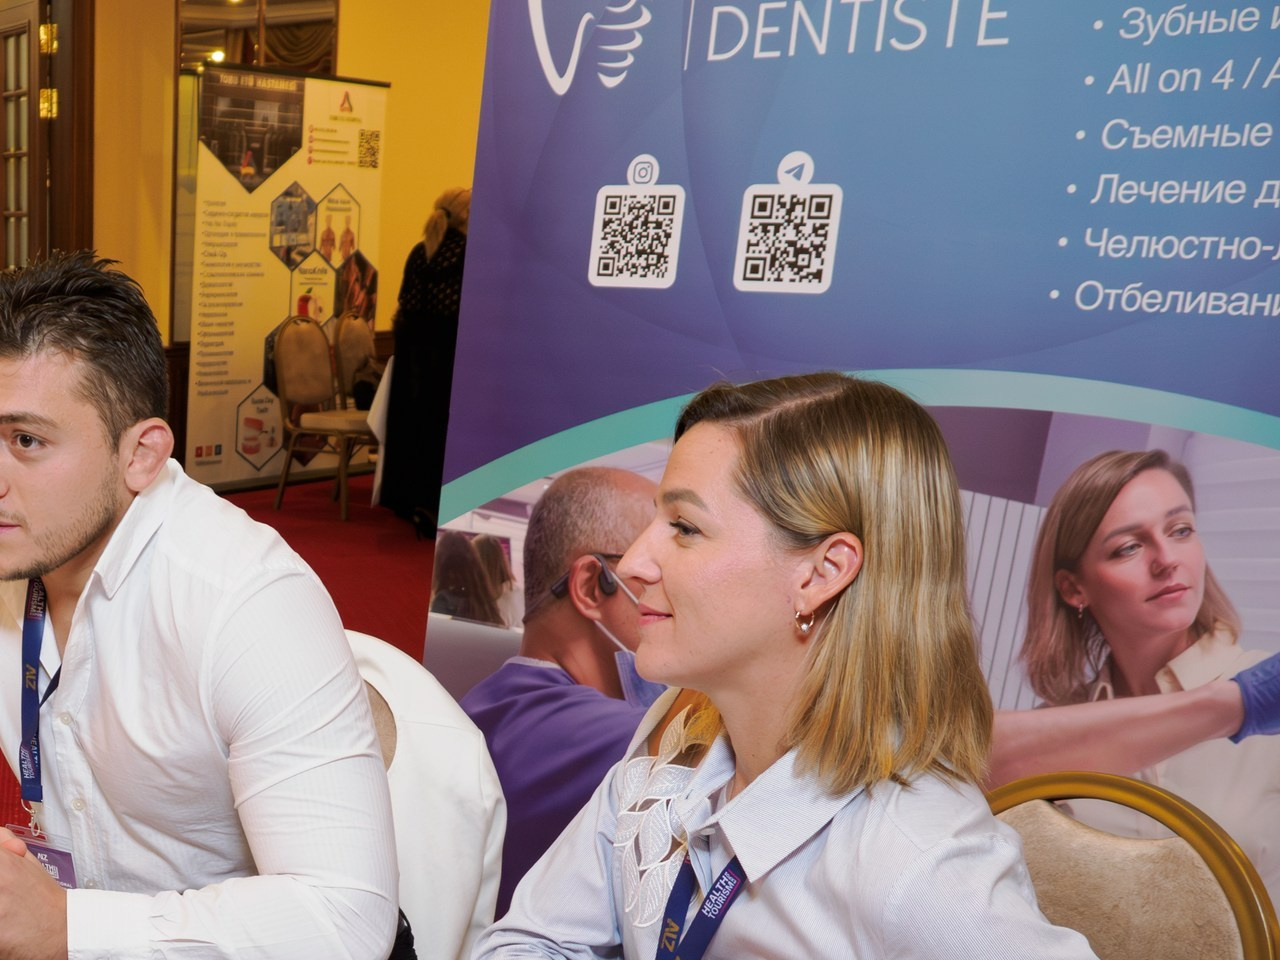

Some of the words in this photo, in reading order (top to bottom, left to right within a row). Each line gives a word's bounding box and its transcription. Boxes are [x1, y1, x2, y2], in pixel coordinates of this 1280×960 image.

[707, 0, 1009, 61] DENTISTE
[1119, 3, 1261, 46] Зубные
[1106, 62, 1151, 95] All
[1158, 67, 1202, 93] on
[1211, 58, 1235, 90] 4
[1101, 118, 1273, 150] Съемные
[1090, 173, 1247, 205] Лечение
[701, 872, 729, 917] HEALTH
[707, 881, 738, 920] TOURISM
